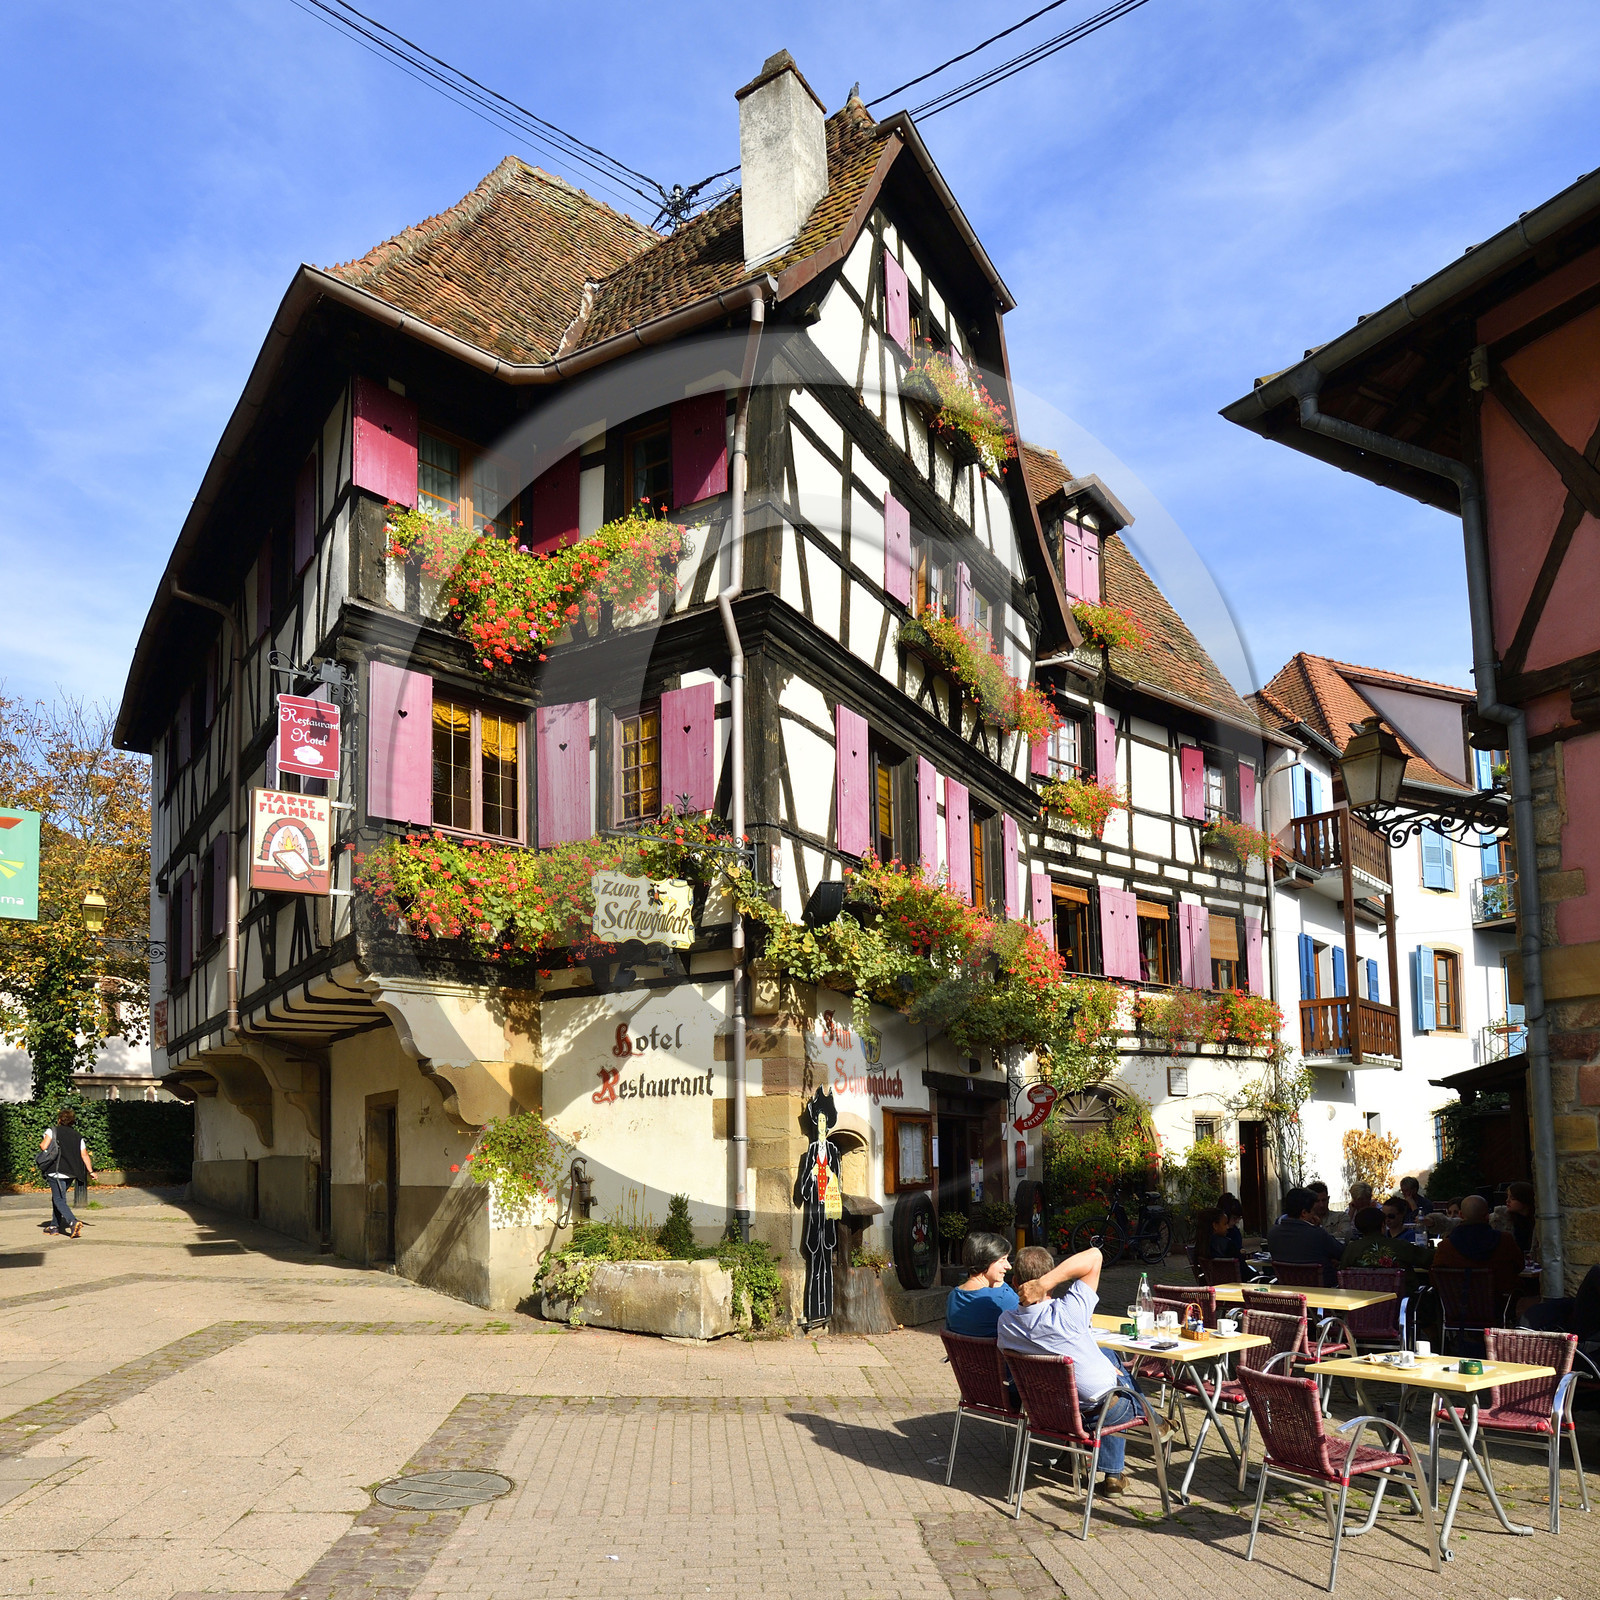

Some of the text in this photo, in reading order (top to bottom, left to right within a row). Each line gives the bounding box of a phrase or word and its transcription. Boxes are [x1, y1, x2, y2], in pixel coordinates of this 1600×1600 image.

[281, 706, 339, 730] Restaurant
[290, 727, 328, 746] Hotel
[263, 792, 316, 809] TARTE
[600, 899, 691, 940] Schnogaloch
[592, 1065, 714, 1105] Restaurant
[834, 1057, 904, 1106] Schnogaloch
